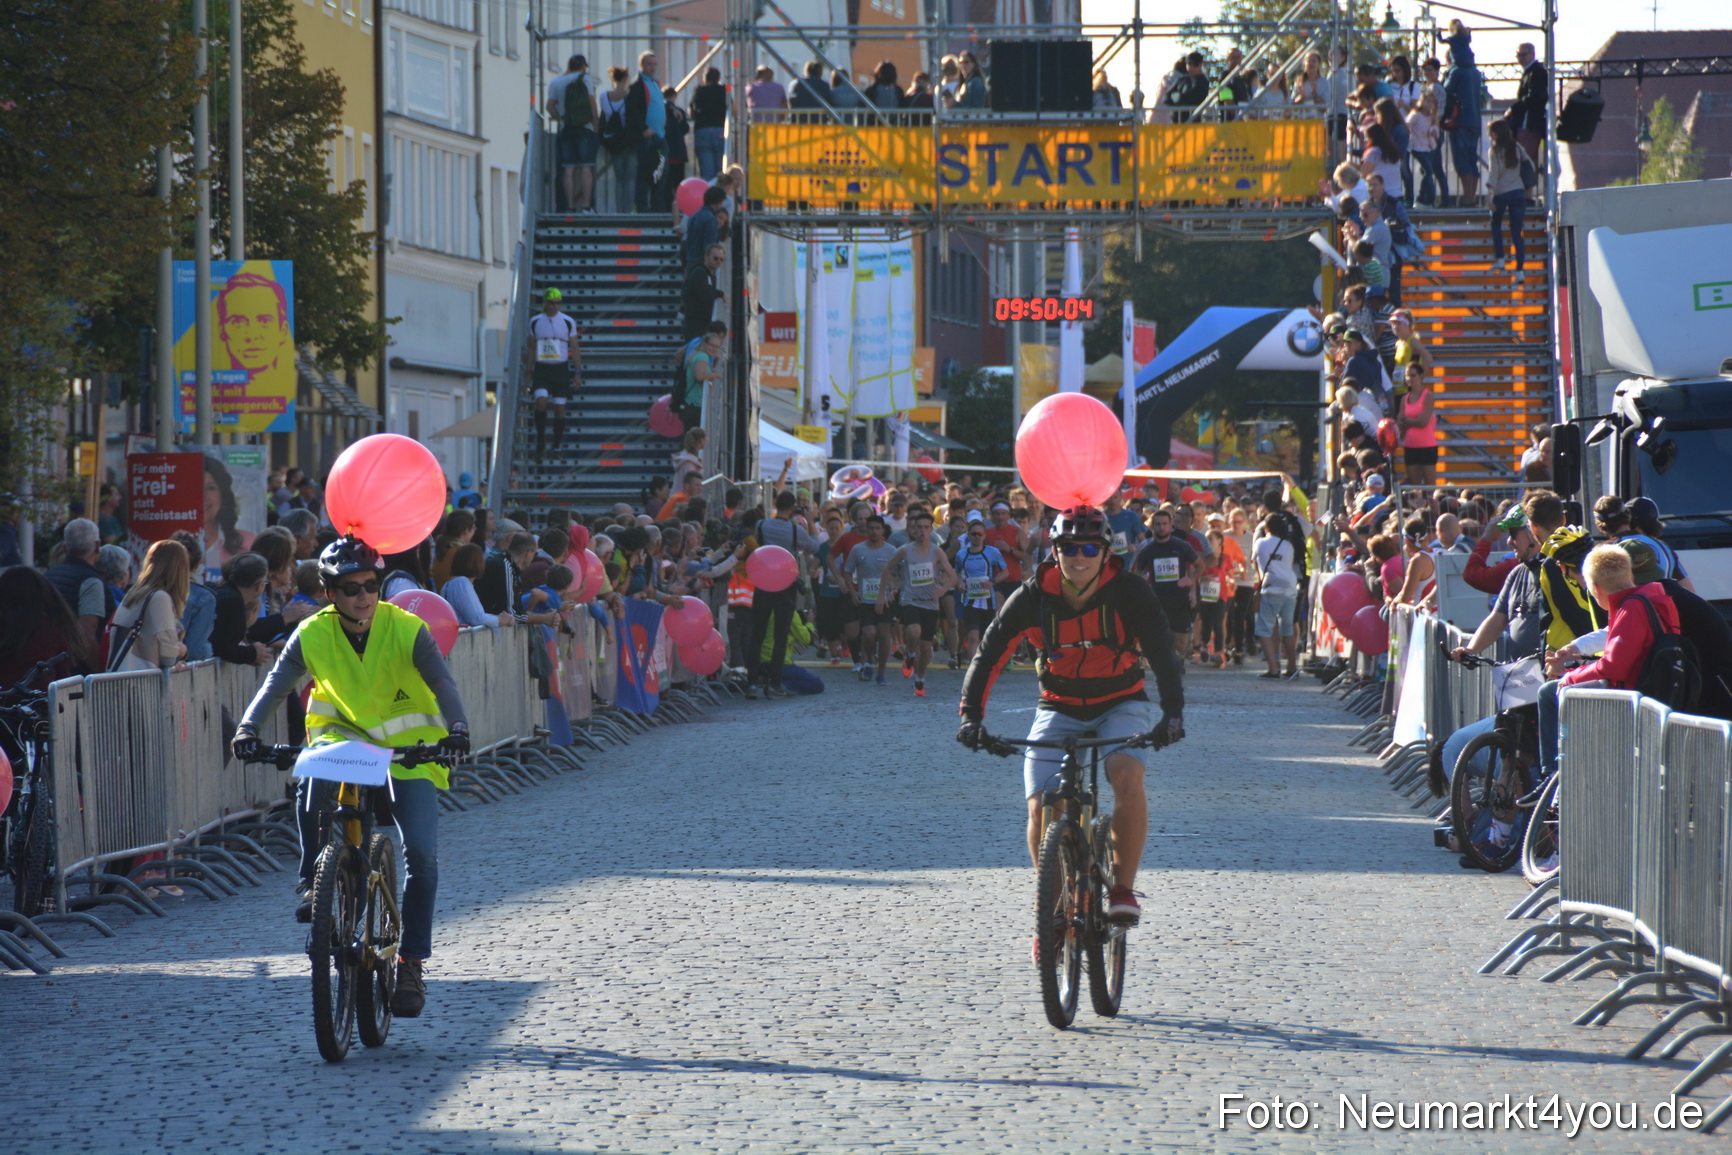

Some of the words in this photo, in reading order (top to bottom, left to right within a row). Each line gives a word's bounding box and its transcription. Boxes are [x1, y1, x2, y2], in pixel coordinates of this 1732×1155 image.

[939, 141, 1133, 188] START
[1168, 164, 1235, 176] Neumarkter
[1239, 162, 1292, 174] Stadtlauf
[1133, 382, 1167, 405] PARTL
[1163, 349, 1221, 389] NEUMARKT
[132, 463, 148, 473] Für
[149, 463, 176, 473] mehr
[132, 475, 176, 496] Frei-
[133, 498, 155, 508] statt
[133, 510, 197, 521] Polizeistaat!
[912, 568, 931, 577] 5173
[1157, 564, 1175, 573] 5194
